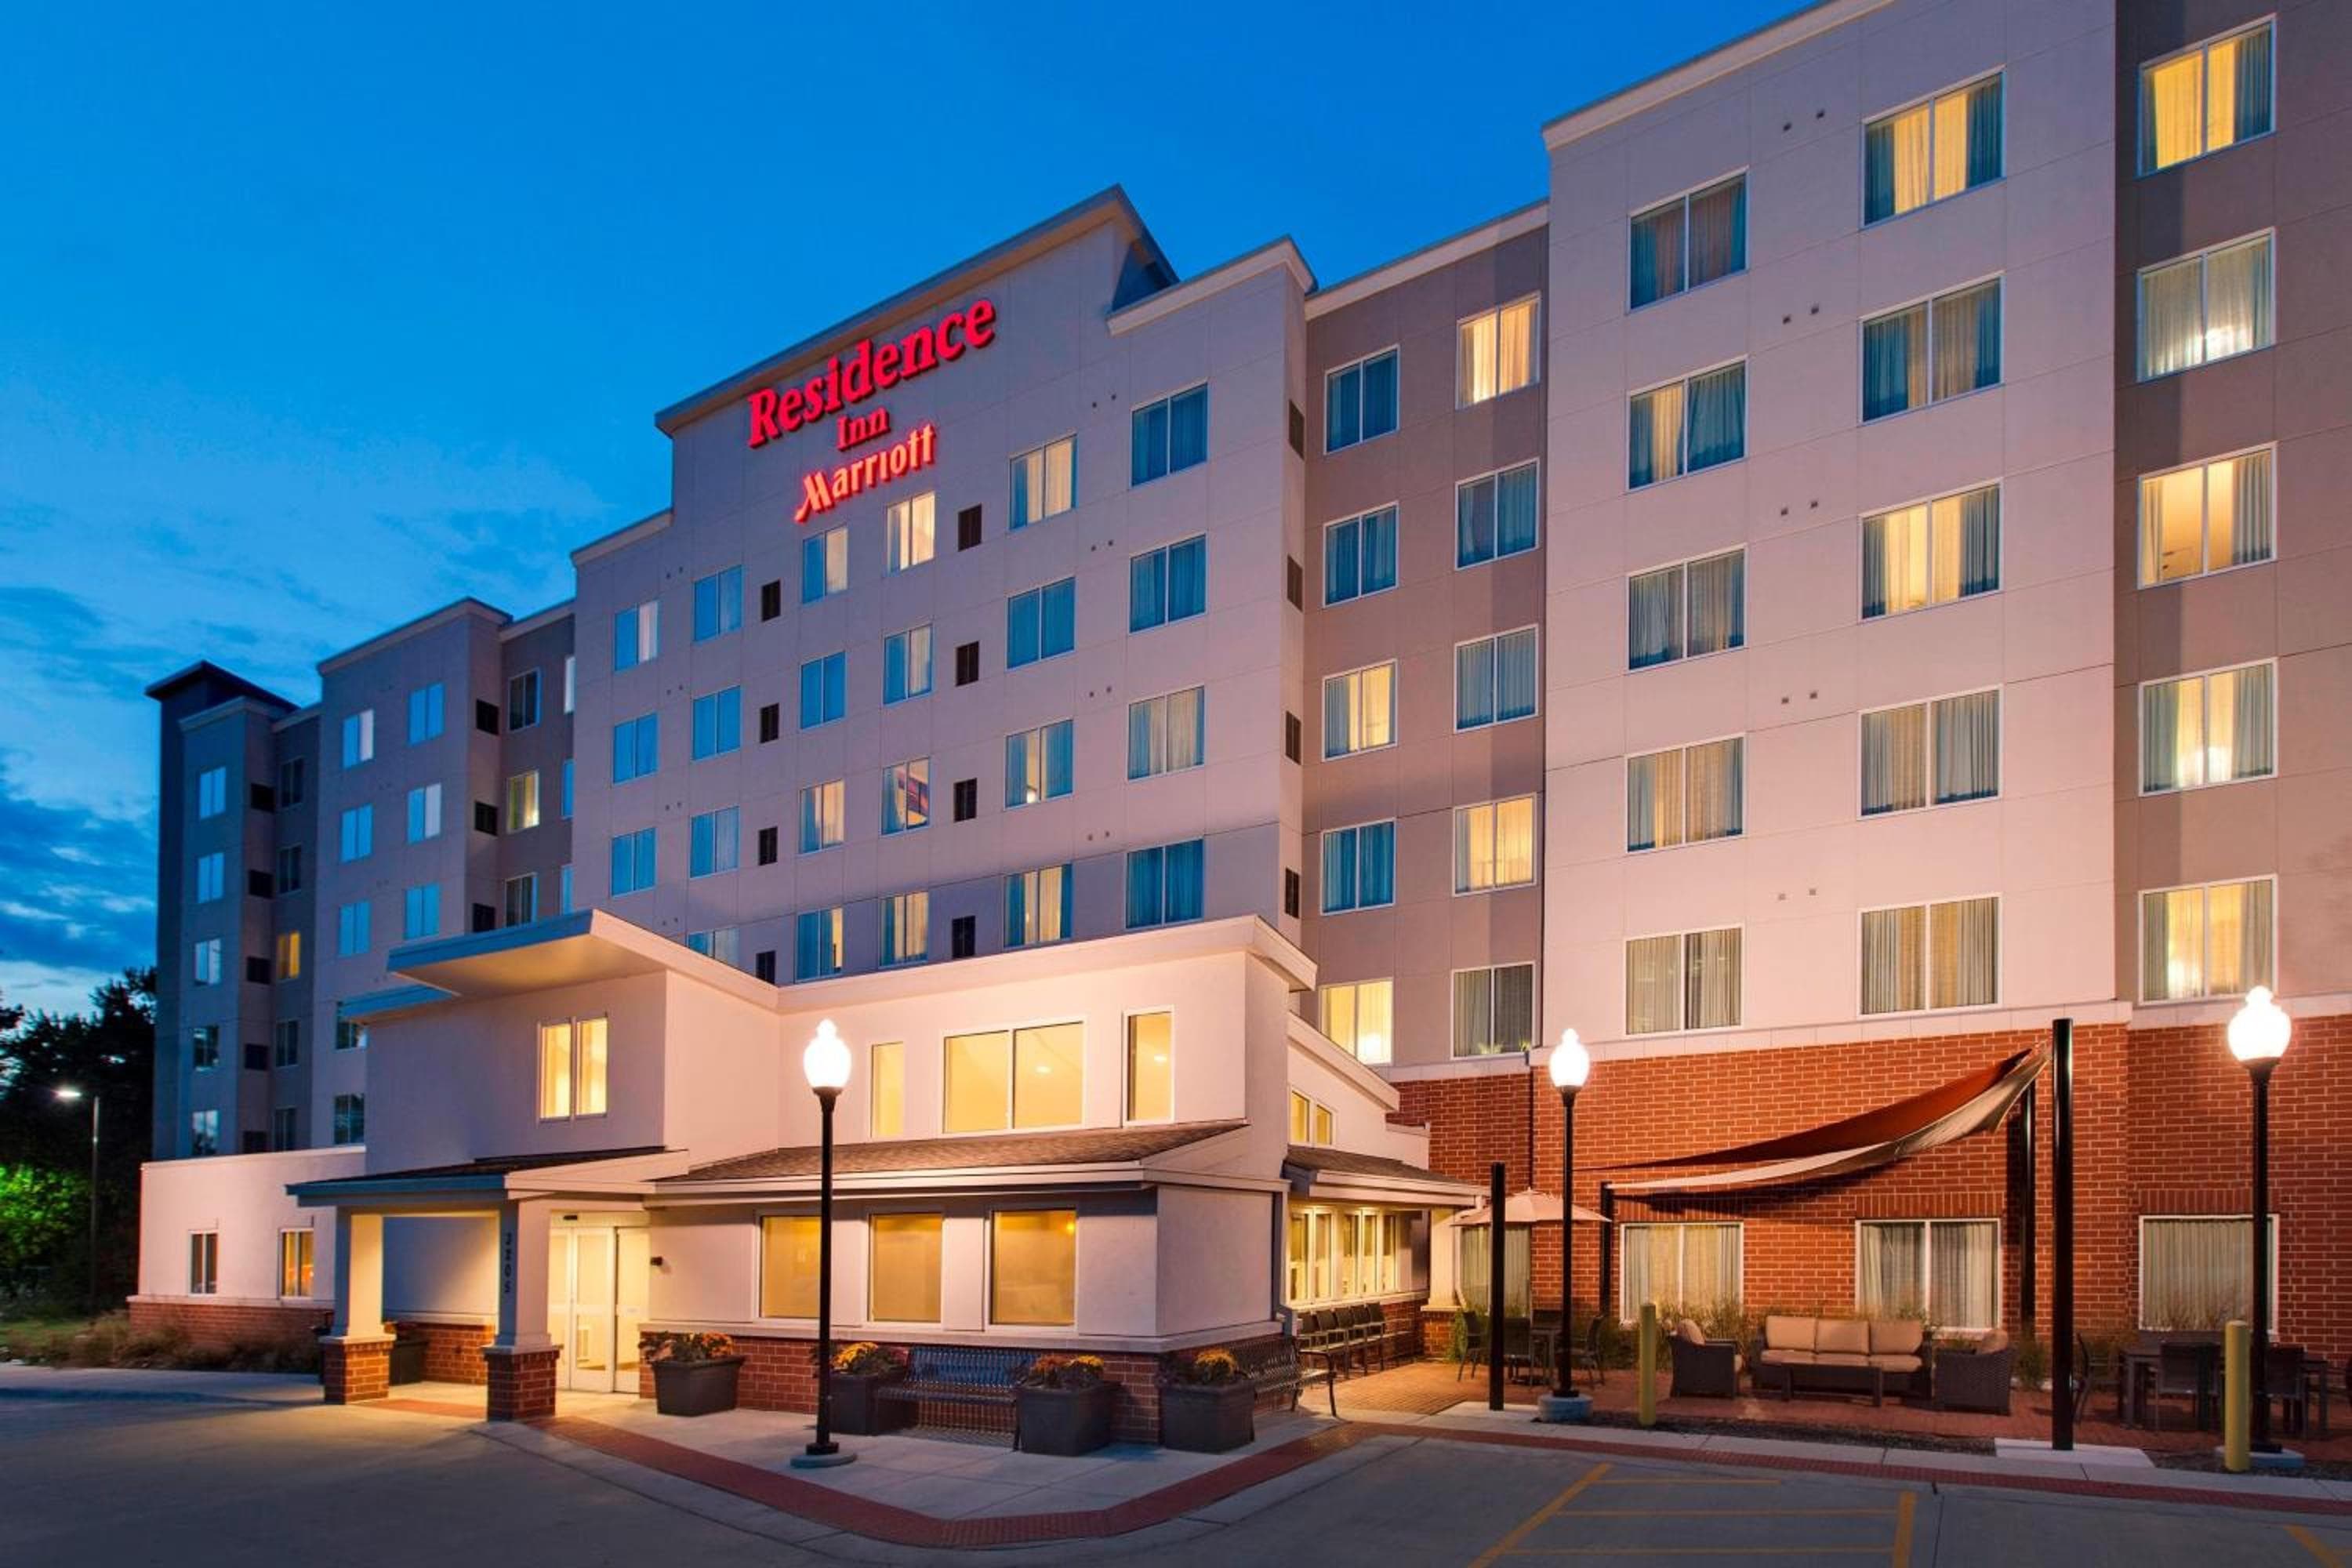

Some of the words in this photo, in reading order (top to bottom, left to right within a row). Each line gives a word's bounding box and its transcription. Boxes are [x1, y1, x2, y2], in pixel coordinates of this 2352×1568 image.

[747, 299, 996, 448] Residence
[794, 423, 935, 523] Marriott
[837, 407, 890, 450] Inn
